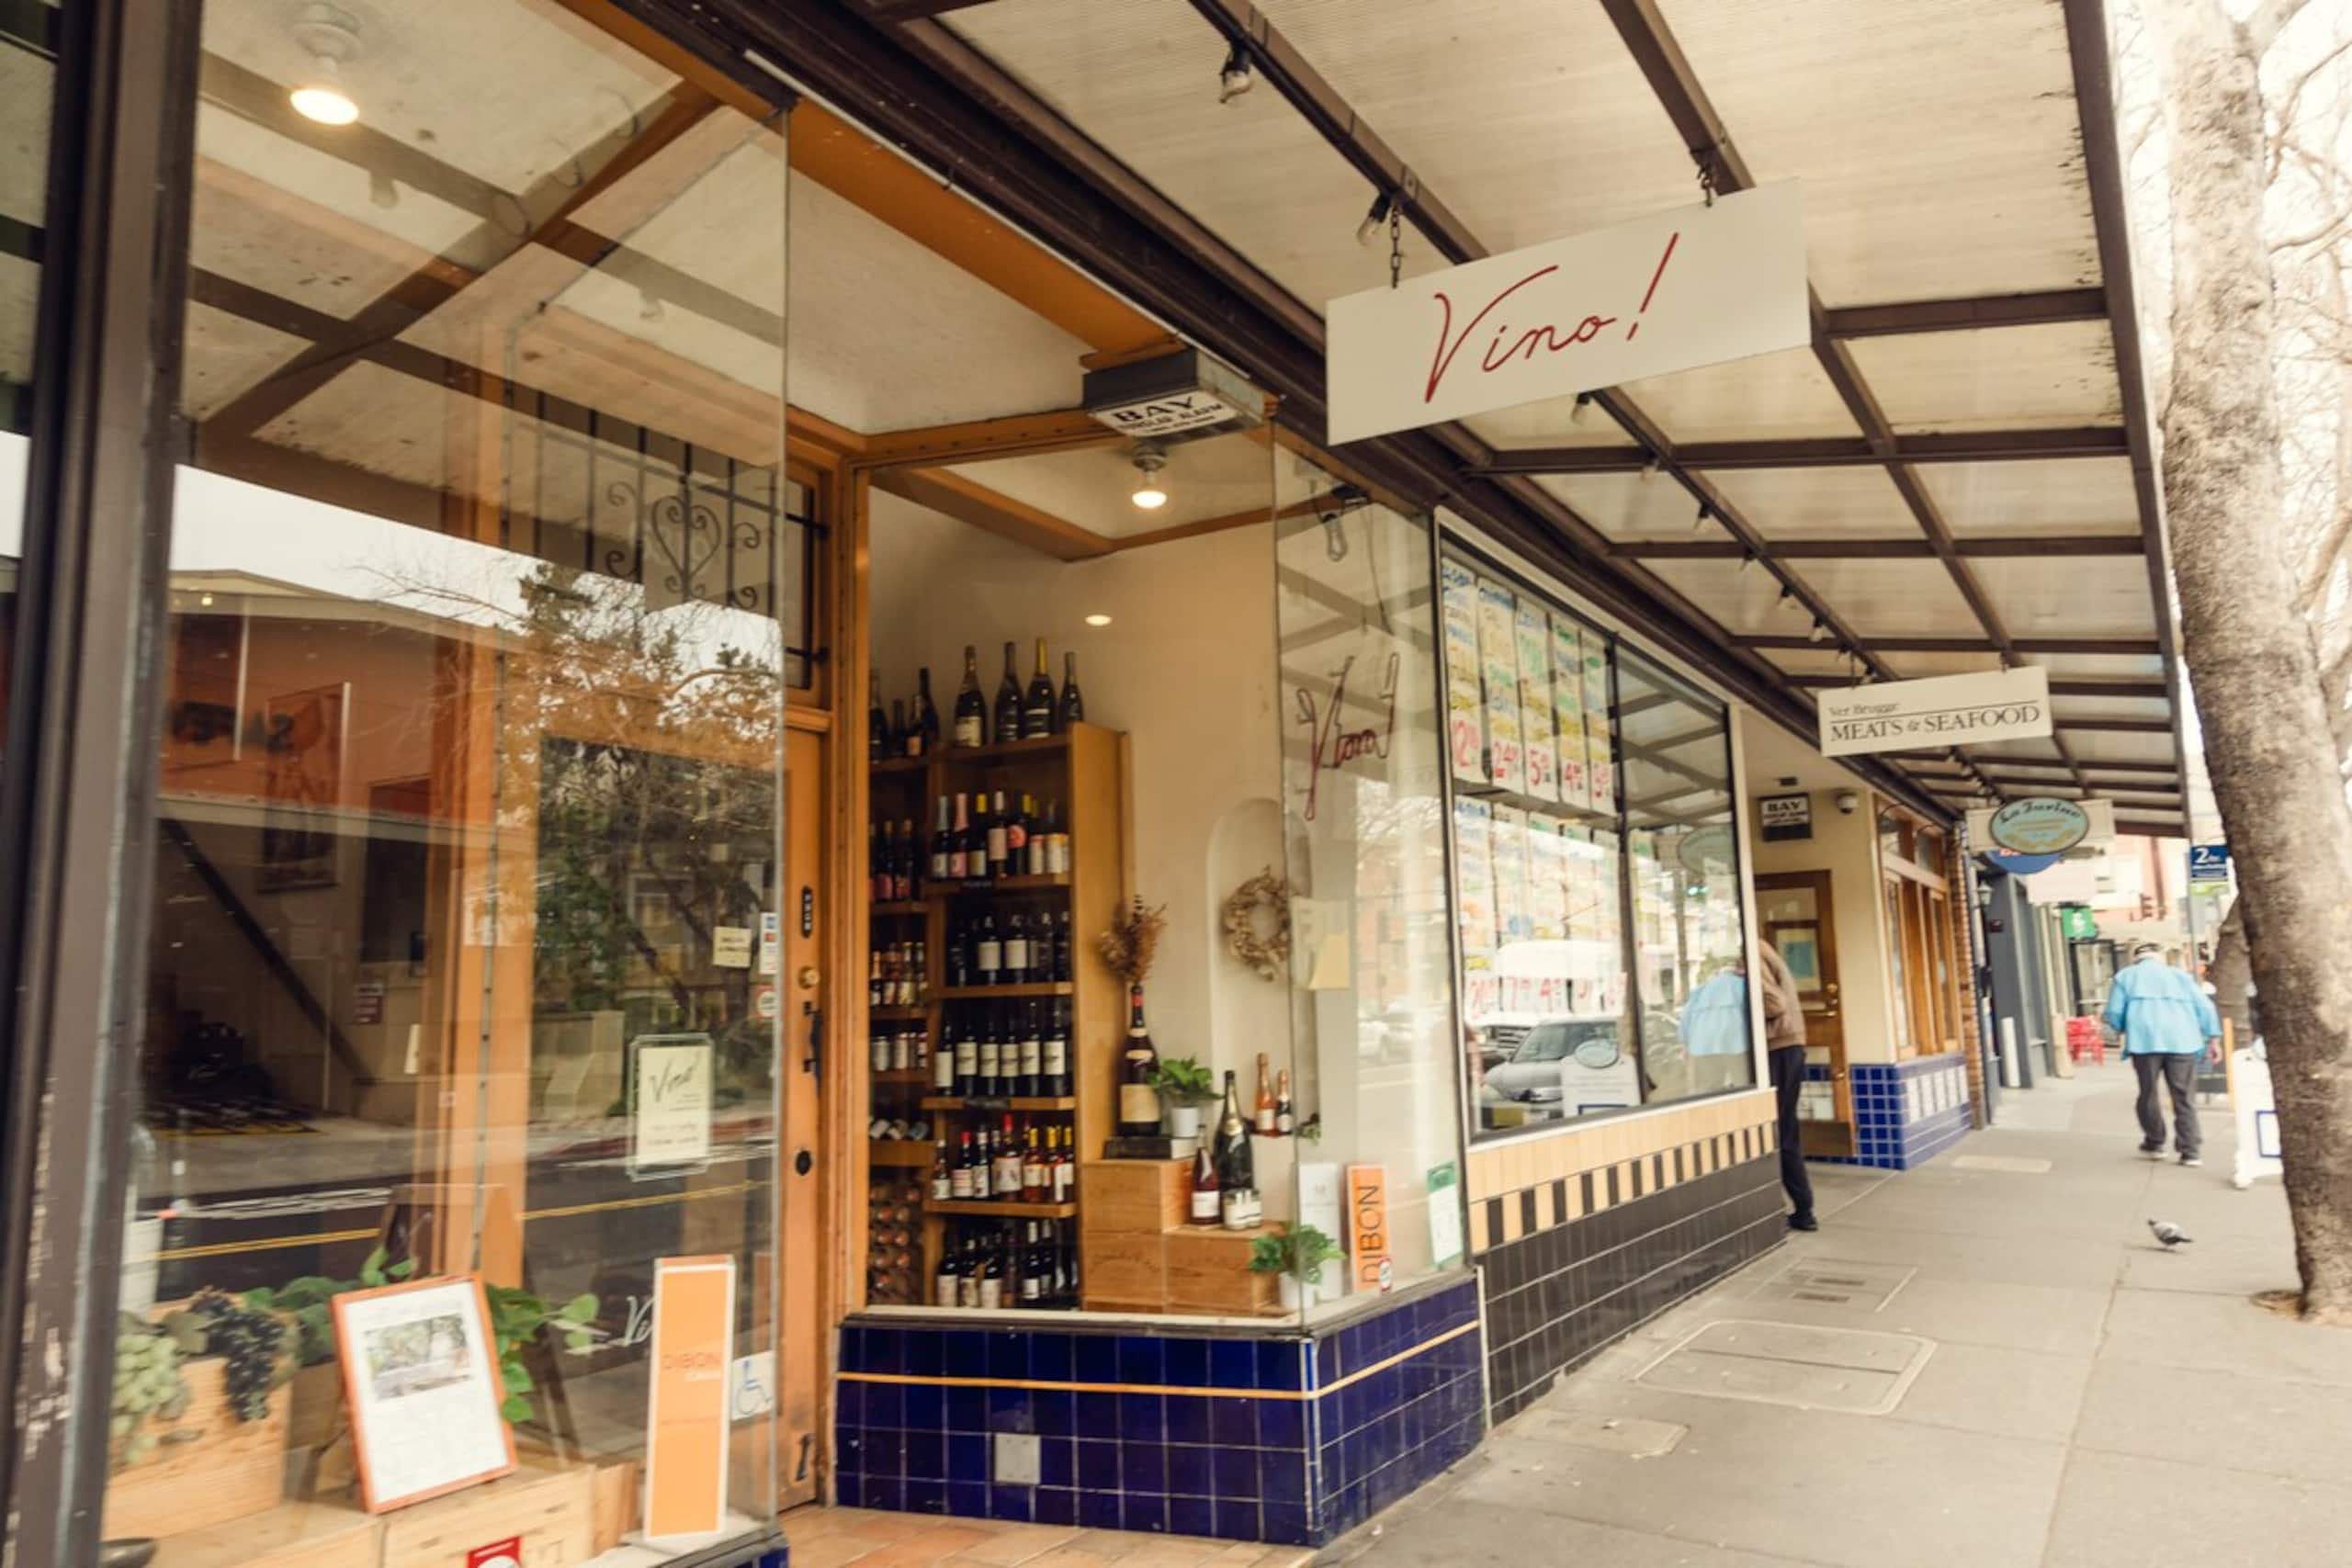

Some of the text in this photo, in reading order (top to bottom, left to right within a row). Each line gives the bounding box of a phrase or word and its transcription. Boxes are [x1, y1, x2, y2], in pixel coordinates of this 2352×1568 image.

[1425, 231, 1679, 403] Vino!
[1114, 396, 1193, 422] BAY
[1830, 705, 2041, 742] MEATS & SEAFOOD
[1357, 1185, 1384, 1284] DIBON
